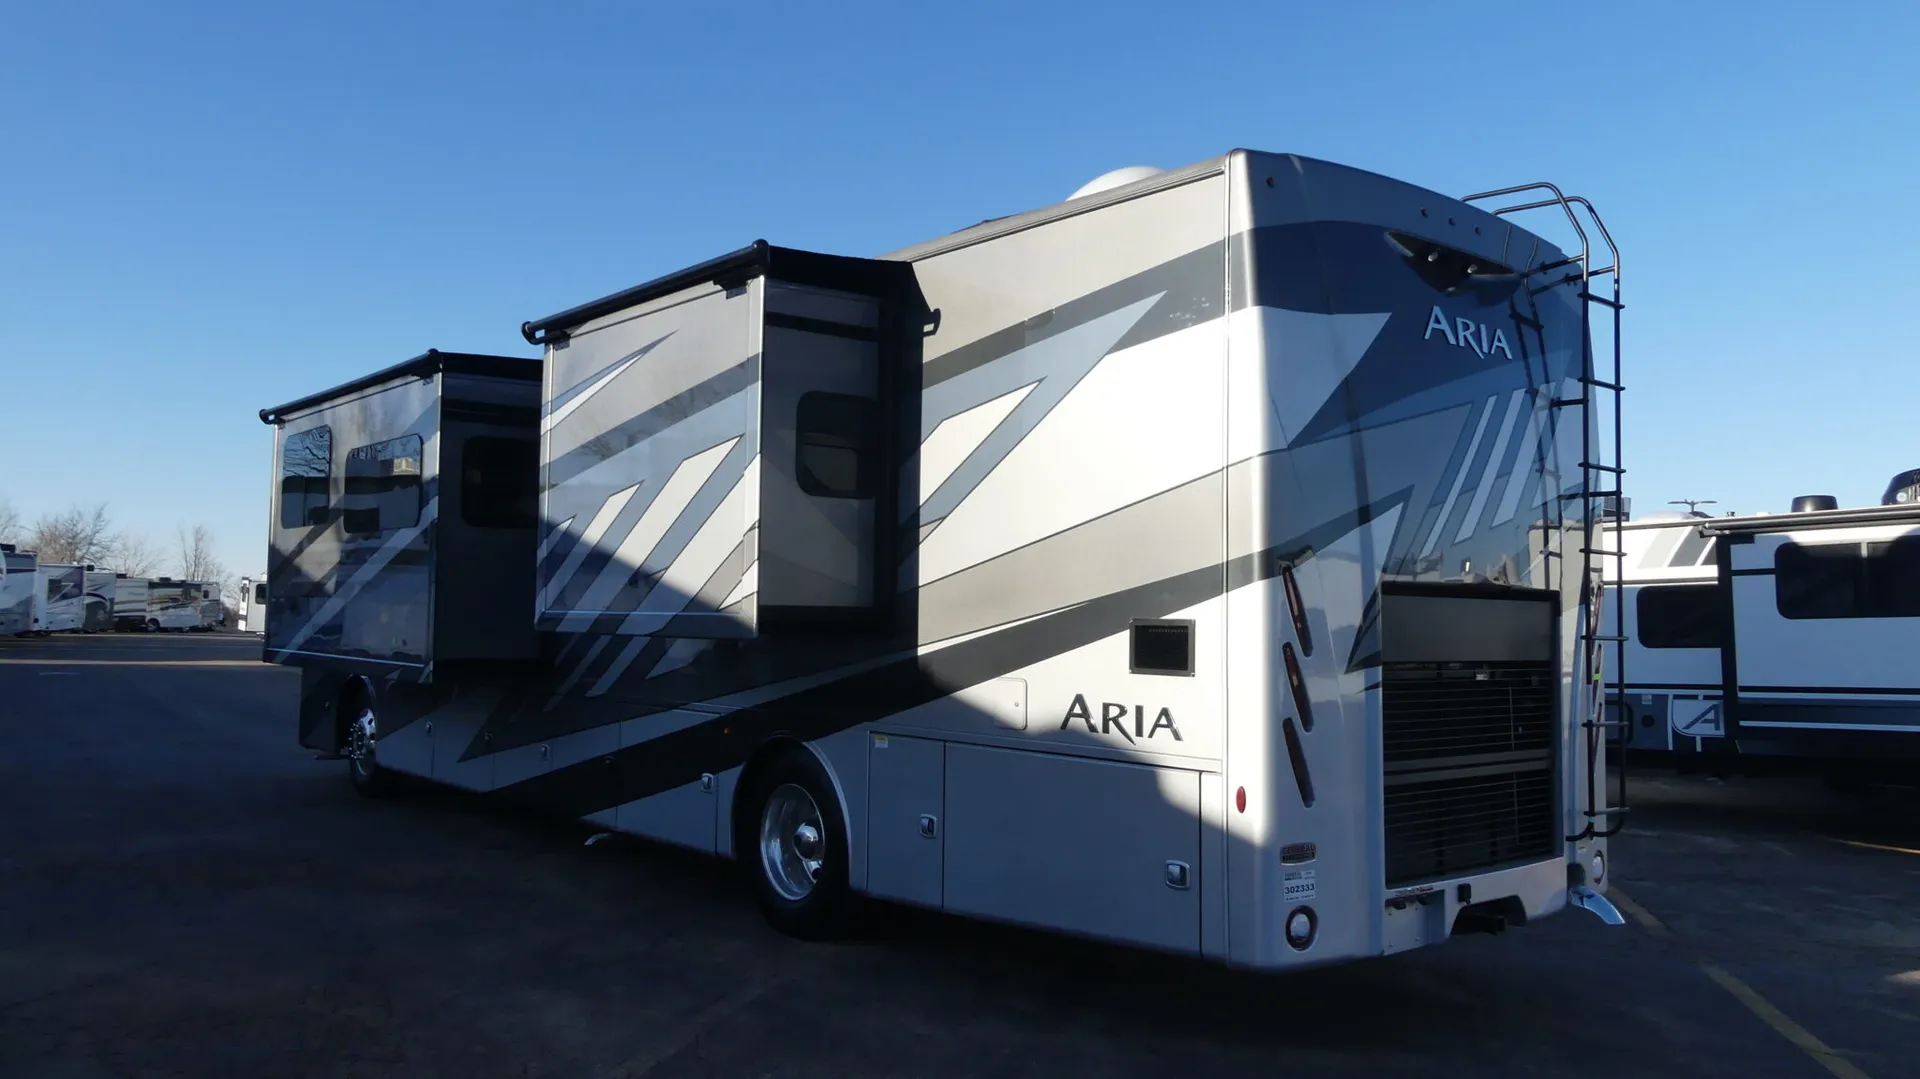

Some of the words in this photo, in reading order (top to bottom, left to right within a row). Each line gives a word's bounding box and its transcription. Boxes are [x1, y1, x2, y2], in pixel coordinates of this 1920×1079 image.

[1424, 305, 1513, 359] ARIA
[1060, 693, 1184, 745] ARIA
[1284, 883, 1315, 894] 302333
